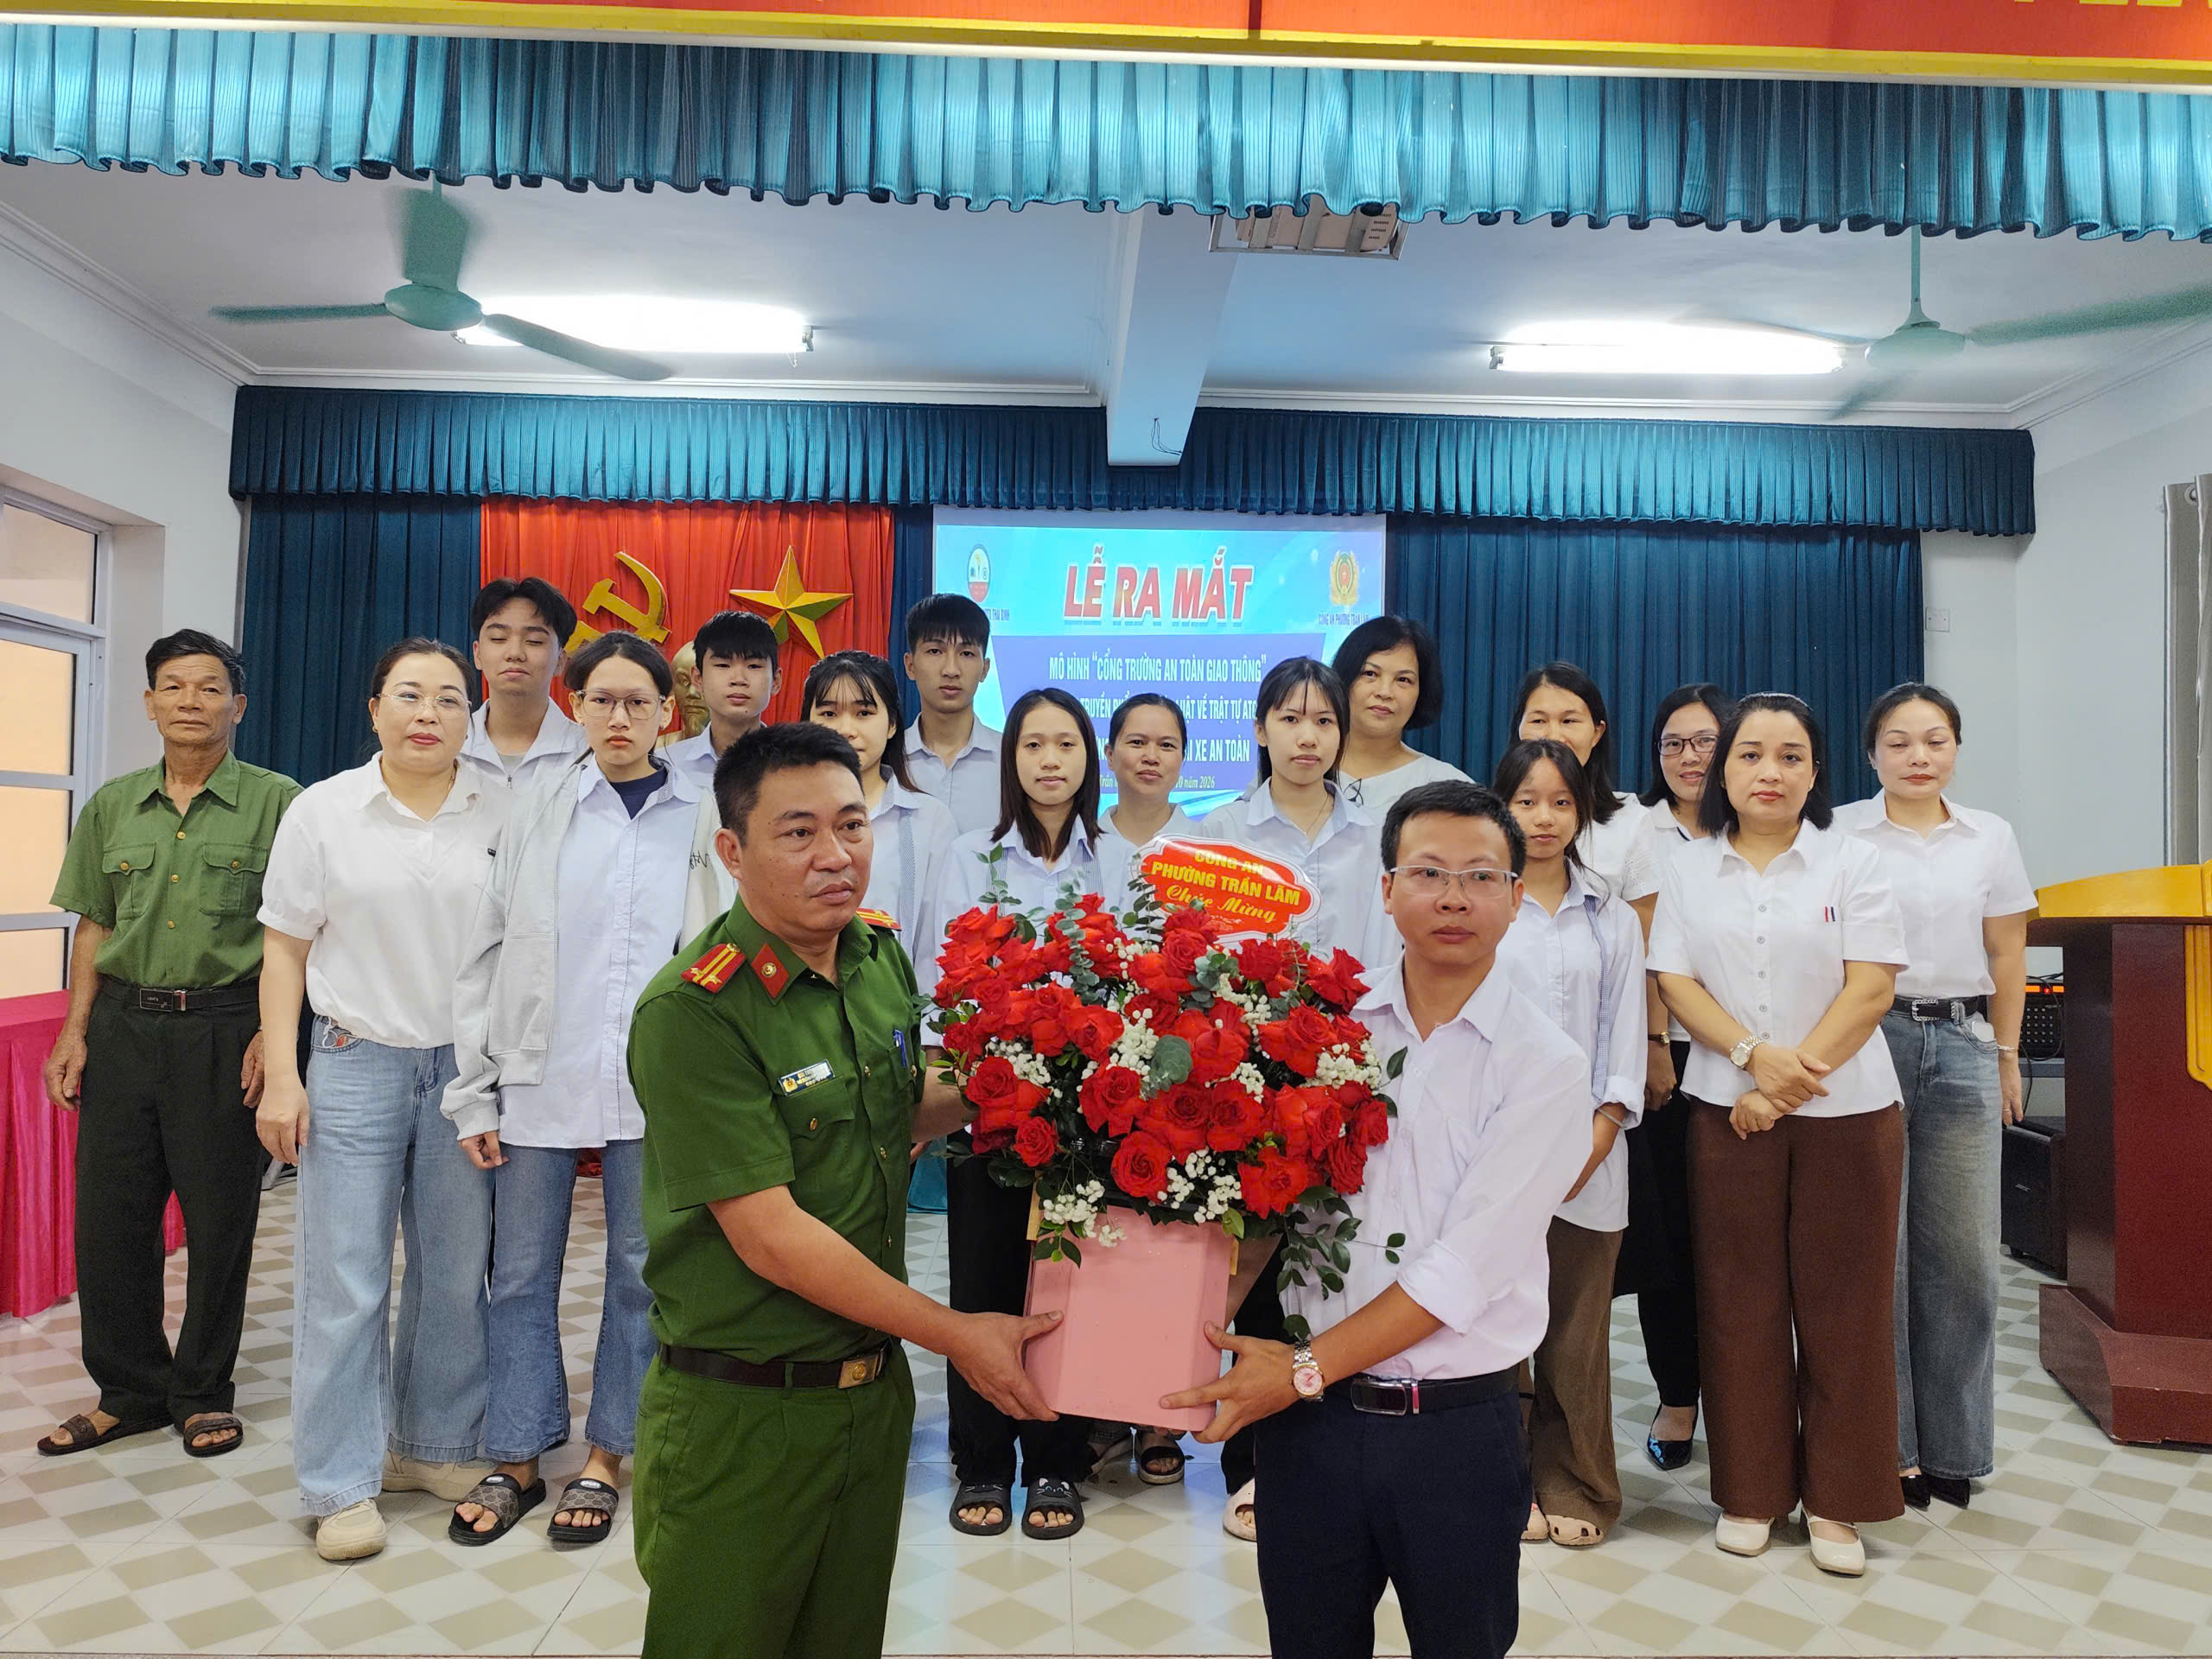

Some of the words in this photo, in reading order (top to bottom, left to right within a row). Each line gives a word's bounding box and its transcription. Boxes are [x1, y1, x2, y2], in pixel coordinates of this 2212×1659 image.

[1063, 544, 1107, 619] LỄ
[1112, 565, 1161, 620] RA
[1171, 547, 1254, 620] MẮT
[1049, 652, 1065, 681] MÔ
[1066, 652, 1090, 681] HÌNH
[1125, 652, 1162, 682] TRƯỜNG
[1164, 658, 1177, 682] AN
[1179, 653, 1204, 682] TOÀN
[1206, 658, 1228, 683] GIAO
[1209, 695, 1229, 724] TRẬT
[1230, 698, 1242, 724] TỰ
[1195, 739, 1207, 762] XE
[1209, 739, 1223, 762] AN
[1225, 734, 1250, 762] TOÀN
[1152, 861, 1217, 888] PHƯỜNG
[1220, 876, 1262, 898] TRẦN
[1265, 884, 1301, 906] LÃM
